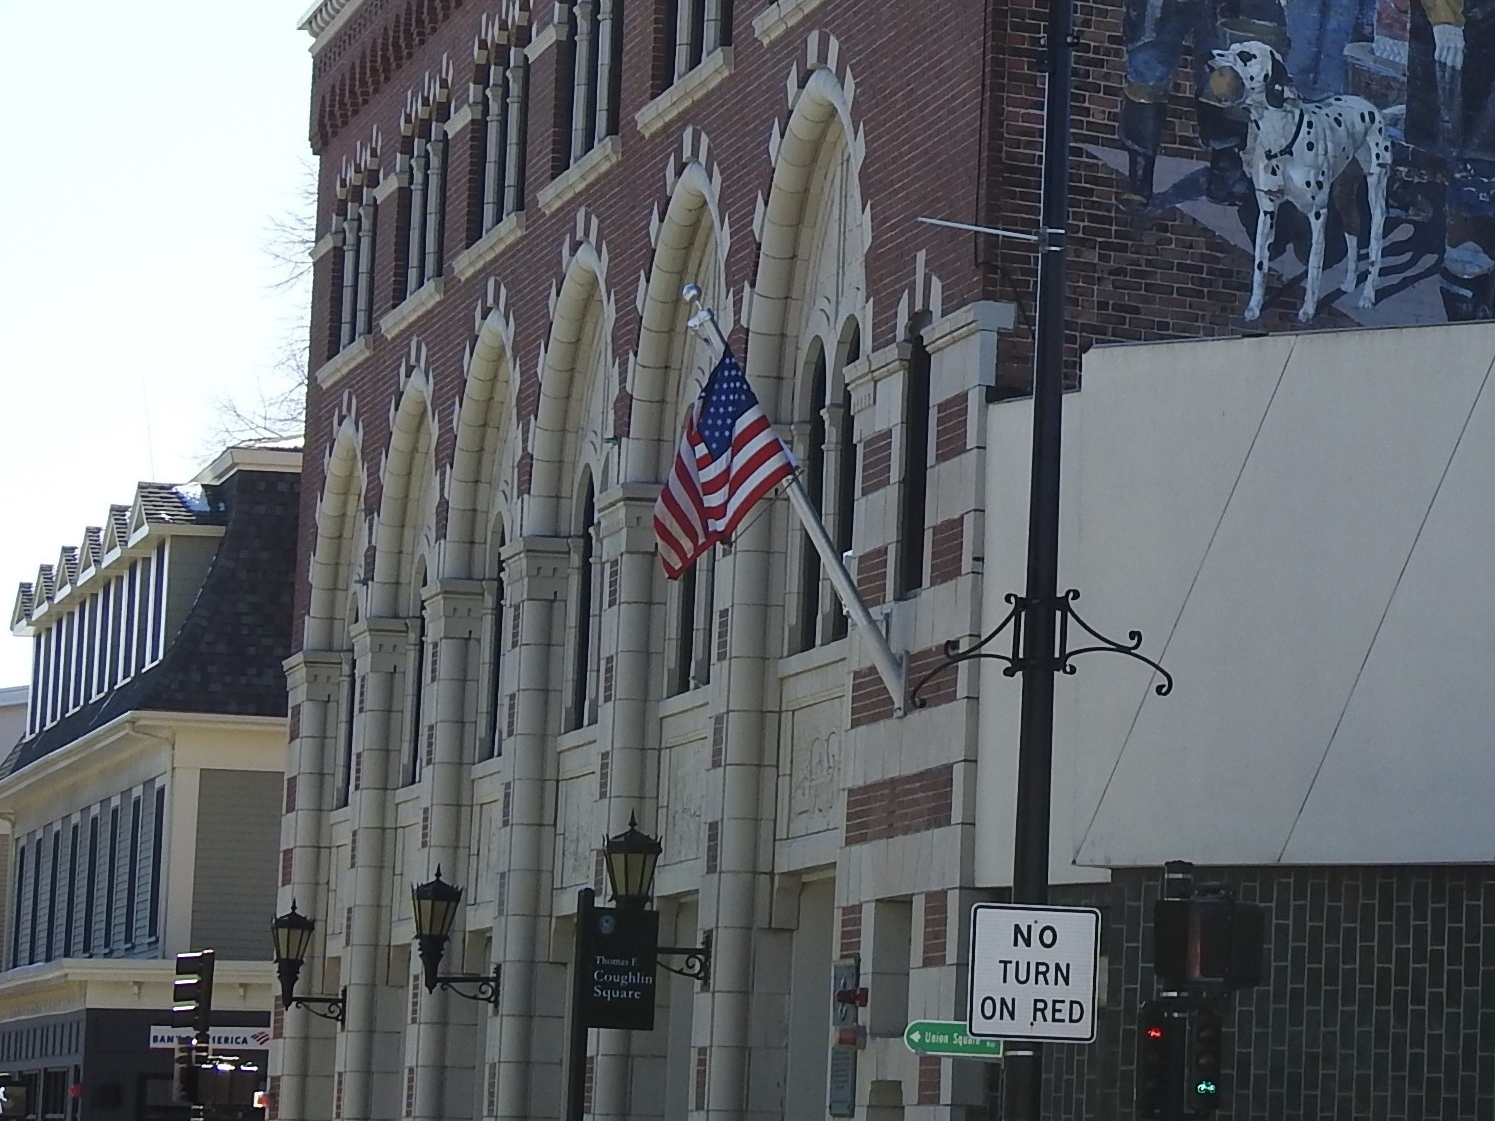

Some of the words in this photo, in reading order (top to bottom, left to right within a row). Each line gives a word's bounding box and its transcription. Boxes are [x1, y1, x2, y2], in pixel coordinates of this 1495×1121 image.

[1013, 924, 1057, 948] NO
[595, 955, 629, 966] Thomas
[593, 969, 653, 987] Coughlin
[999, 960, 1070, 986] TURN
[593, 984, 642, 1002] Square
[981, 996, 1015, 1020] ON
[1033, 998, 1084, 1023] RED
[925, 1031, 949, 1043] Union
[953, 1033, 981, 1046] Square
